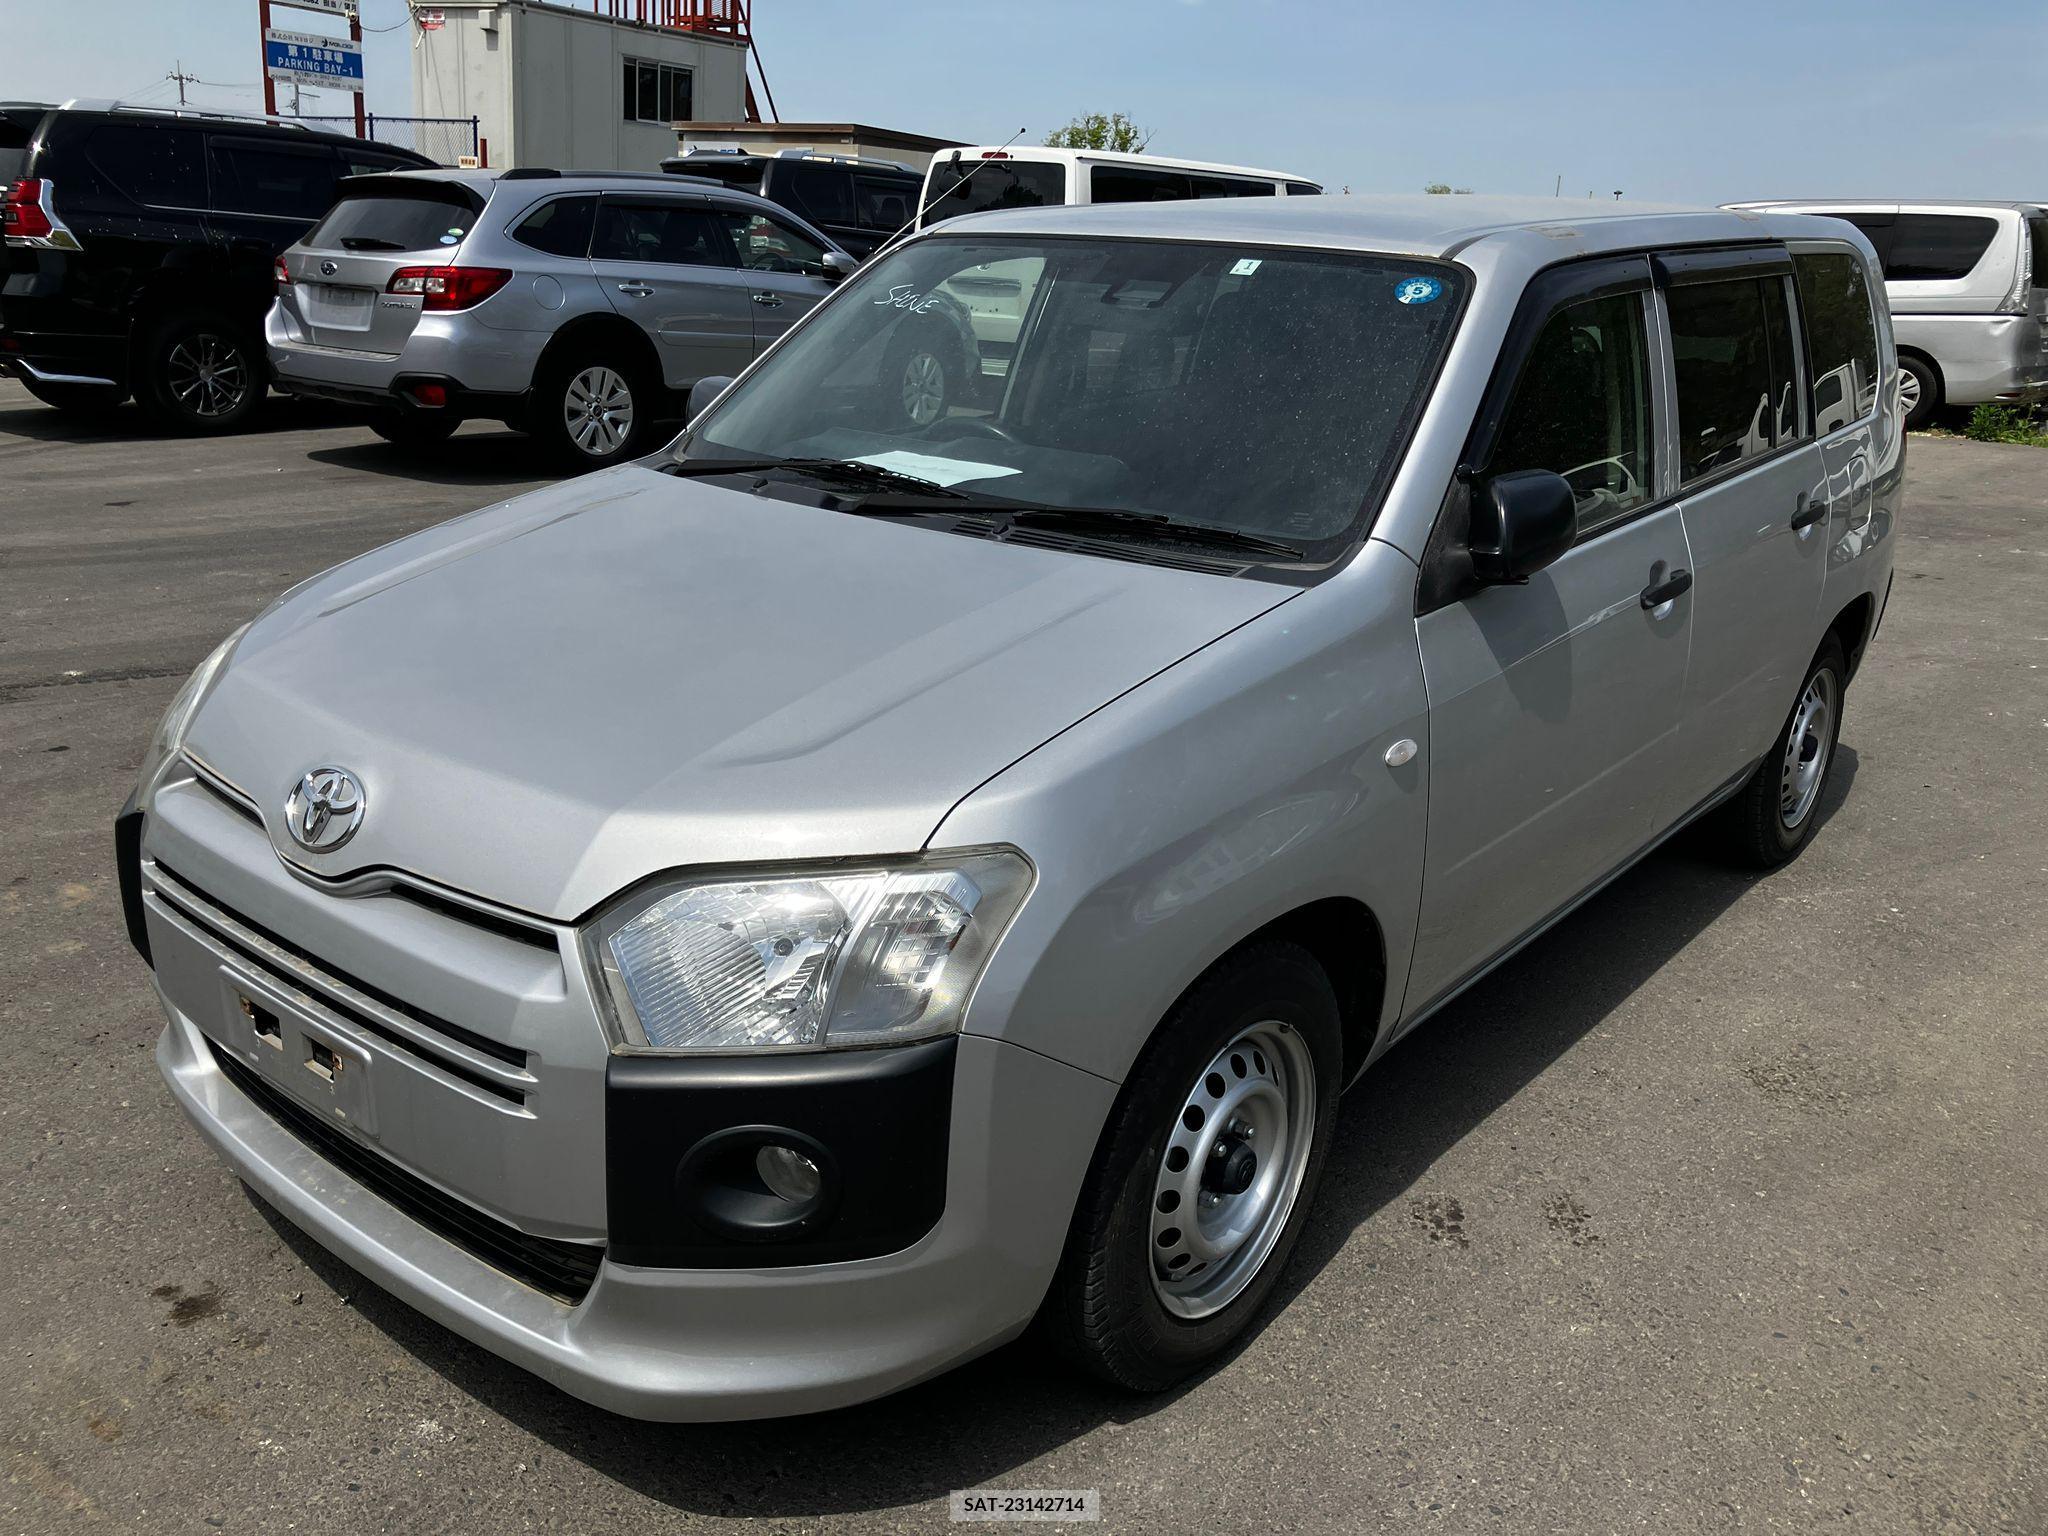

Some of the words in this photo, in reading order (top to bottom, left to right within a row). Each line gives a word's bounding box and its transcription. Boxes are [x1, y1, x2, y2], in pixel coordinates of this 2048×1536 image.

[277, 57, 320, 71] PARKING
[324, 63, 353, 76] BAY-1
[1412, 286, 1424, 295] 5
